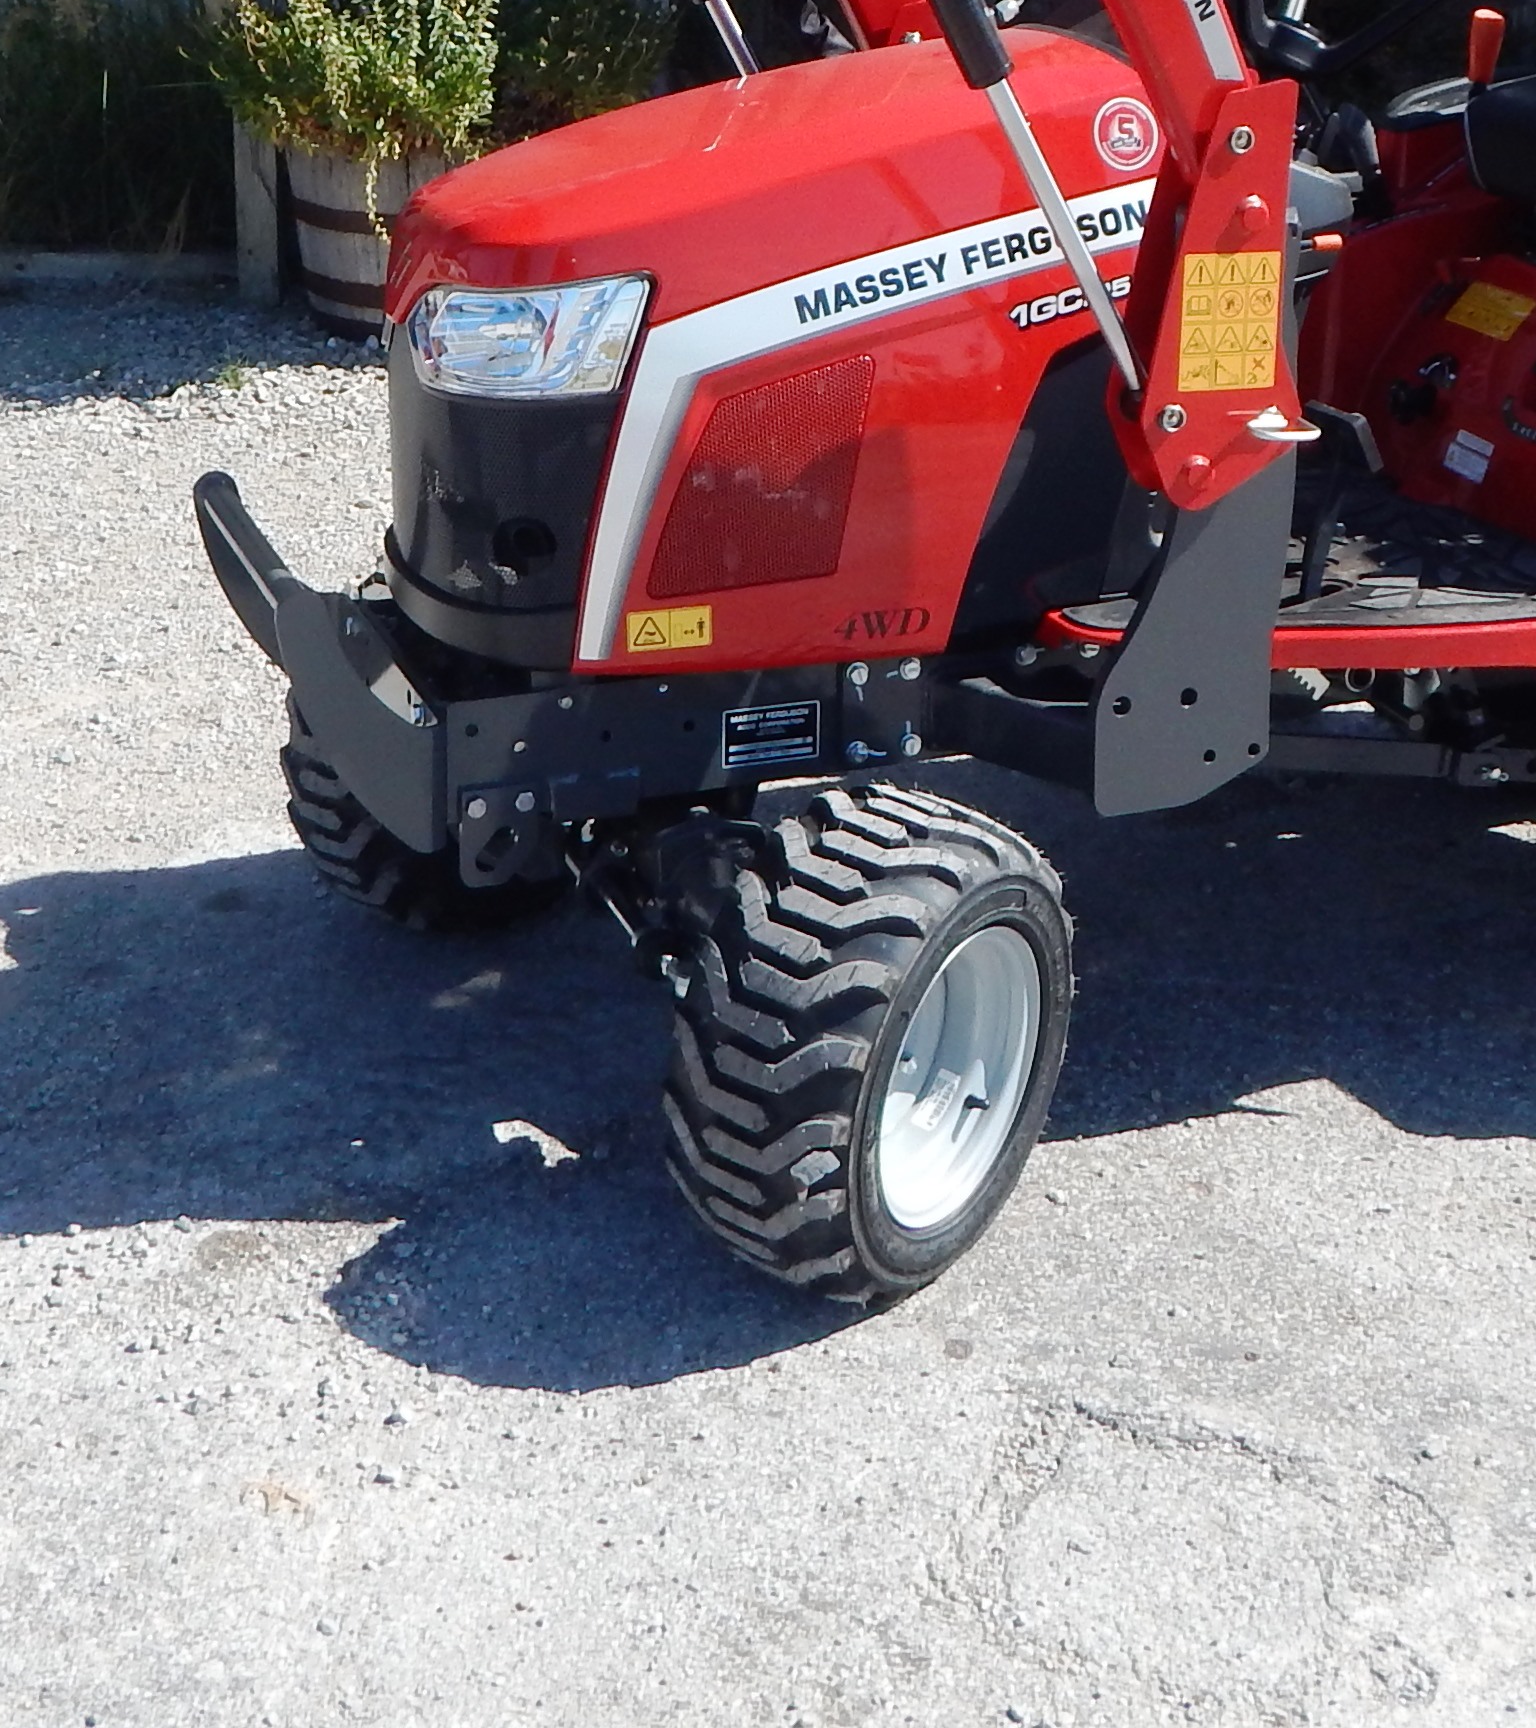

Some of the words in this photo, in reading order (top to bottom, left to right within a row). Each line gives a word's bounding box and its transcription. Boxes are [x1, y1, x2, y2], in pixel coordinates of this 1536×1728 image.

[794, 253, 947, 324] MASSEY
[961, 200, 1150, 275] FERGSON
[834, 607, 931, 640] 4WD
